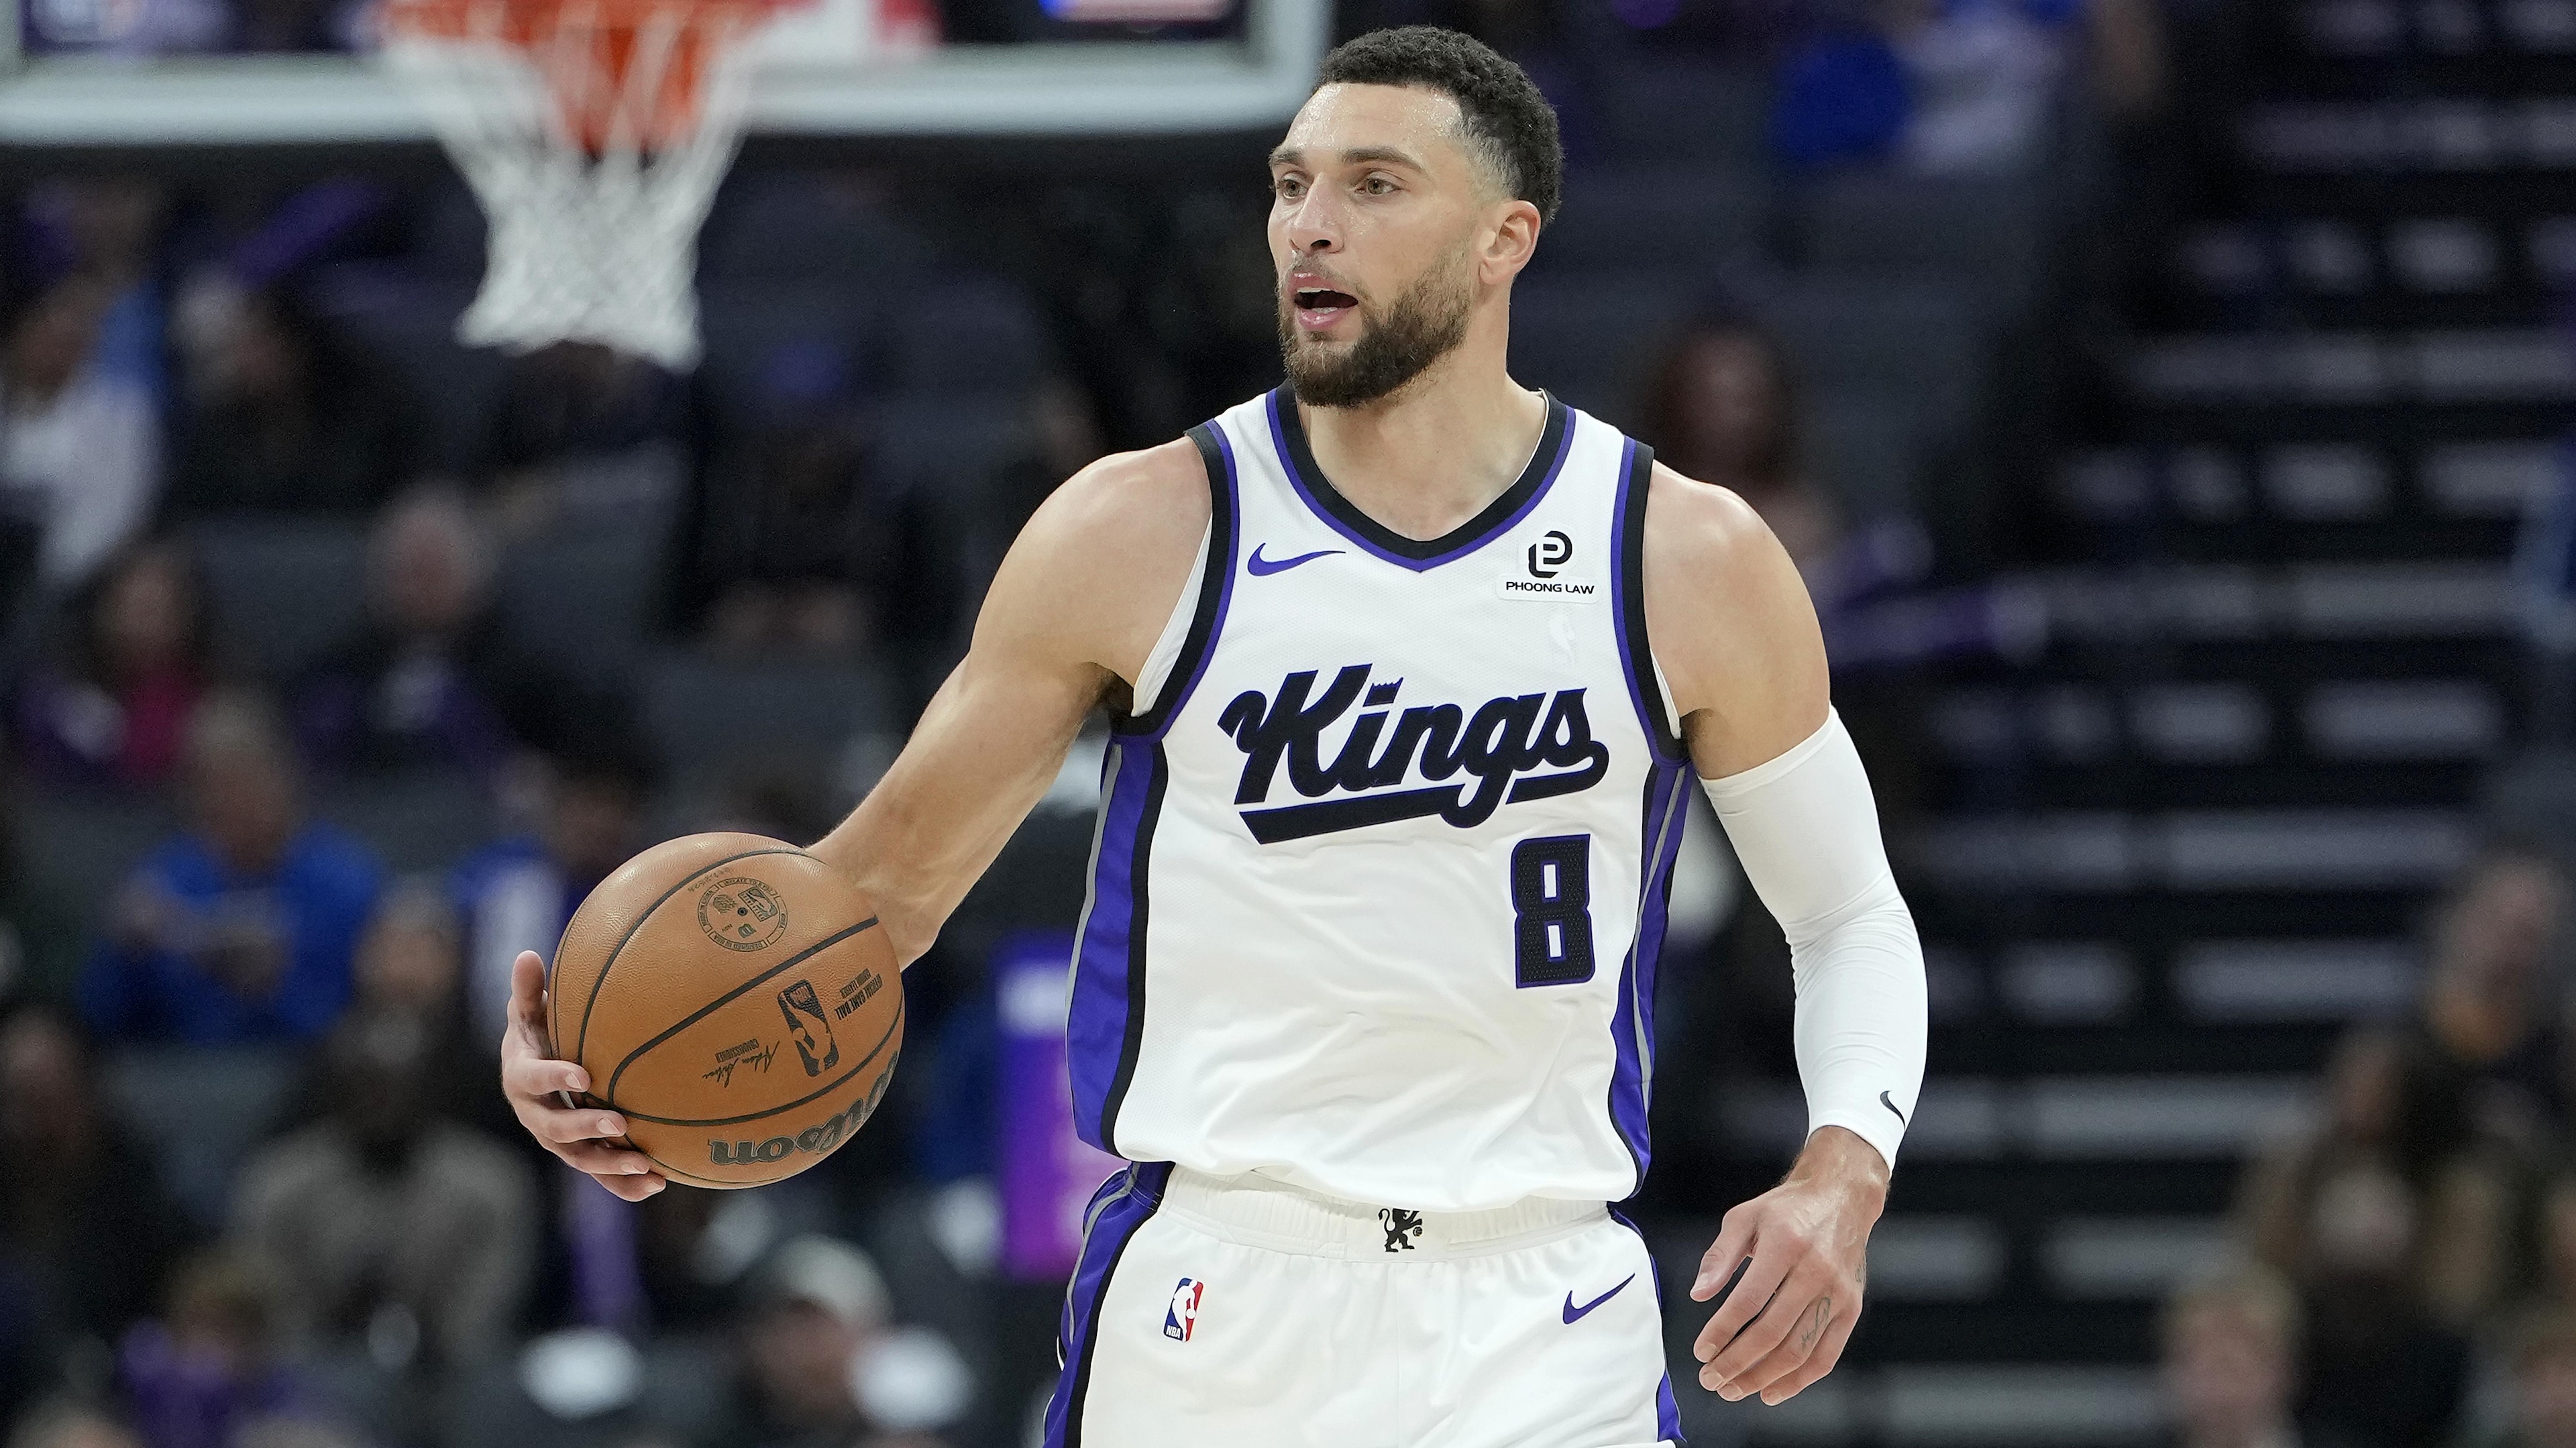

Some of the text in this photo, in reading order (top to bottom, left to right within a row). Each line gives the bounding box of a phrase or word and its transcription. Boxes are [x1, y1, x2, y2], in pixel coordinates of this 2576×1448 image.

[1506, 581, 1595, 594] PHOONG LAW
[1217, 663, 1609, 845] Kings
[1510, 834, 1595, 989] 8
[834, 1001, 852, 1020] BALL
[848, 990, 866, 1011] GAME
[1166, 1325, 1181, 1339] NBA
